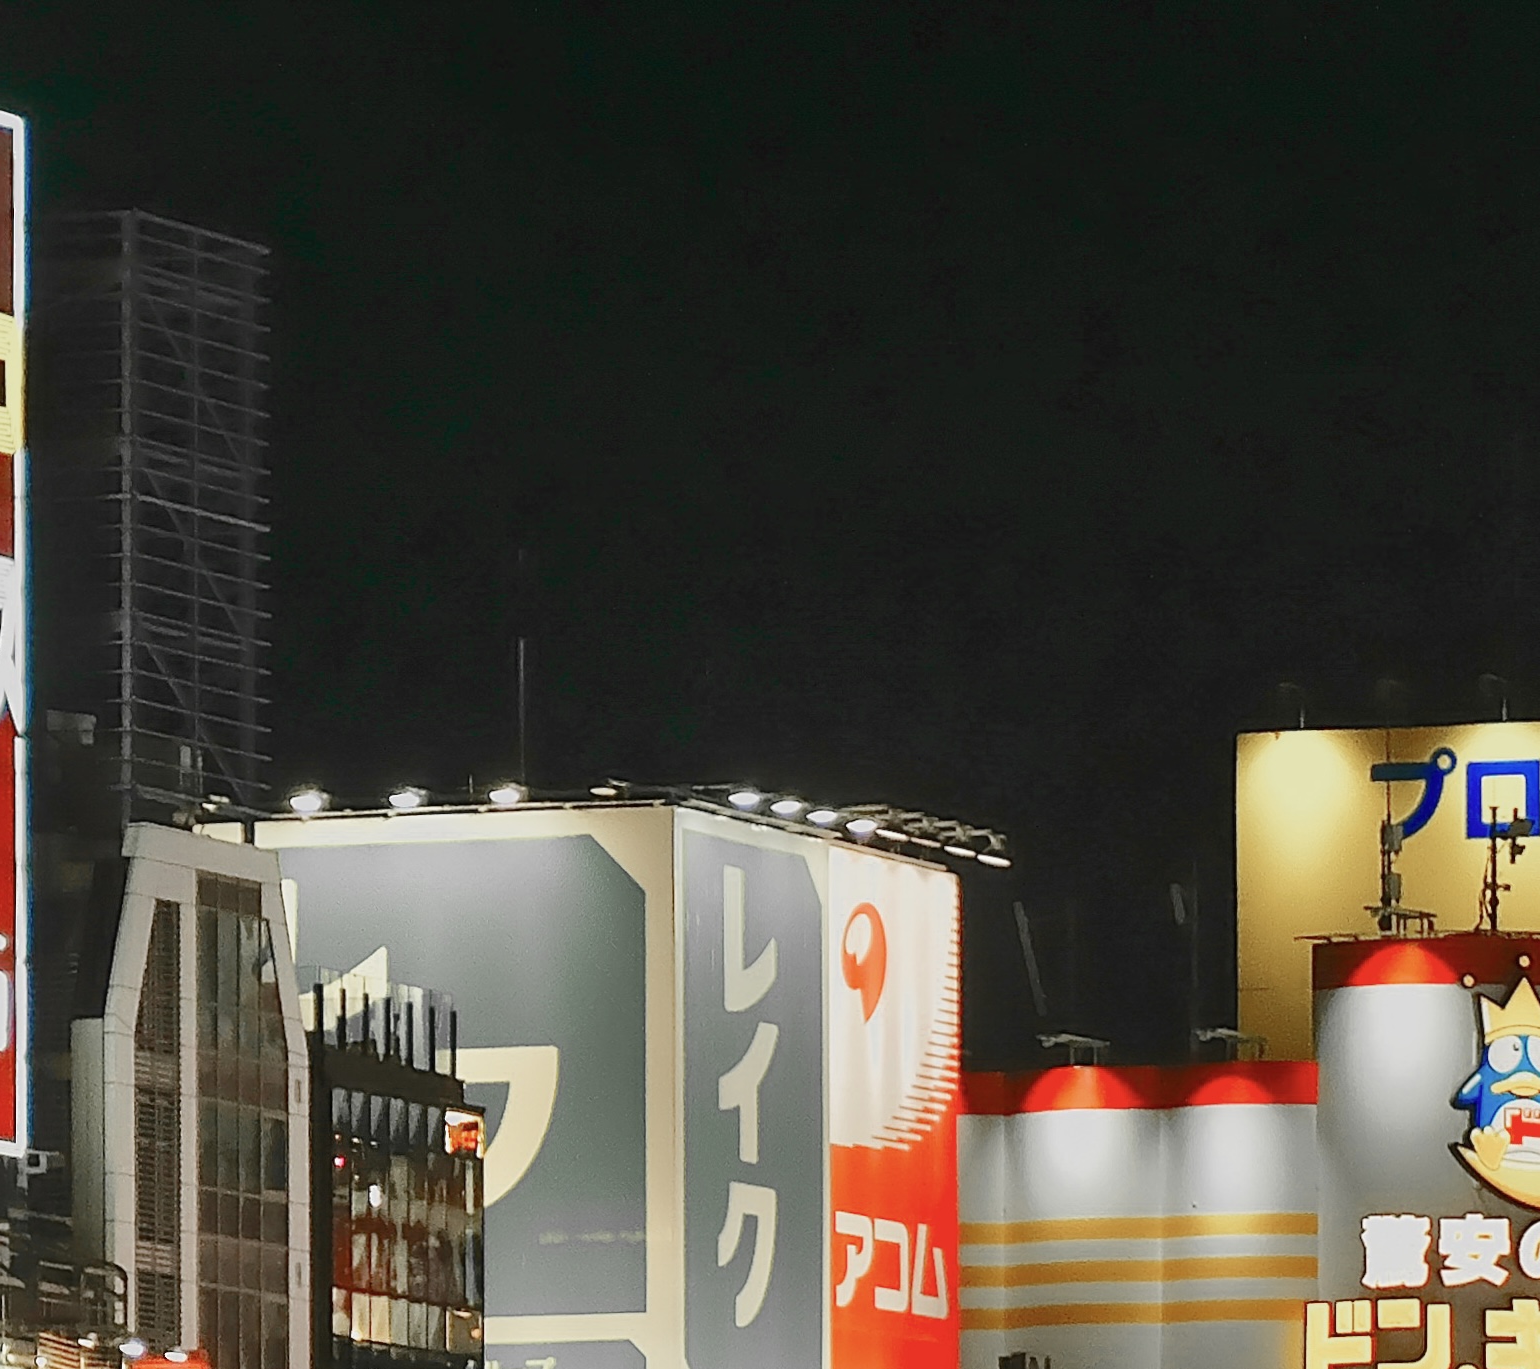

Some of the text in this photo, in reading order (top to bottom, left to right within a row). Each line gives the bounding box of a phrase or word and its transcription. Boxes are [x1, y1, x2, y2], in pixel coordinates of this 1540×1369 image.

[718, 862, 780, 1329] レイク
[834, 1209, 950, 1321] アコム
